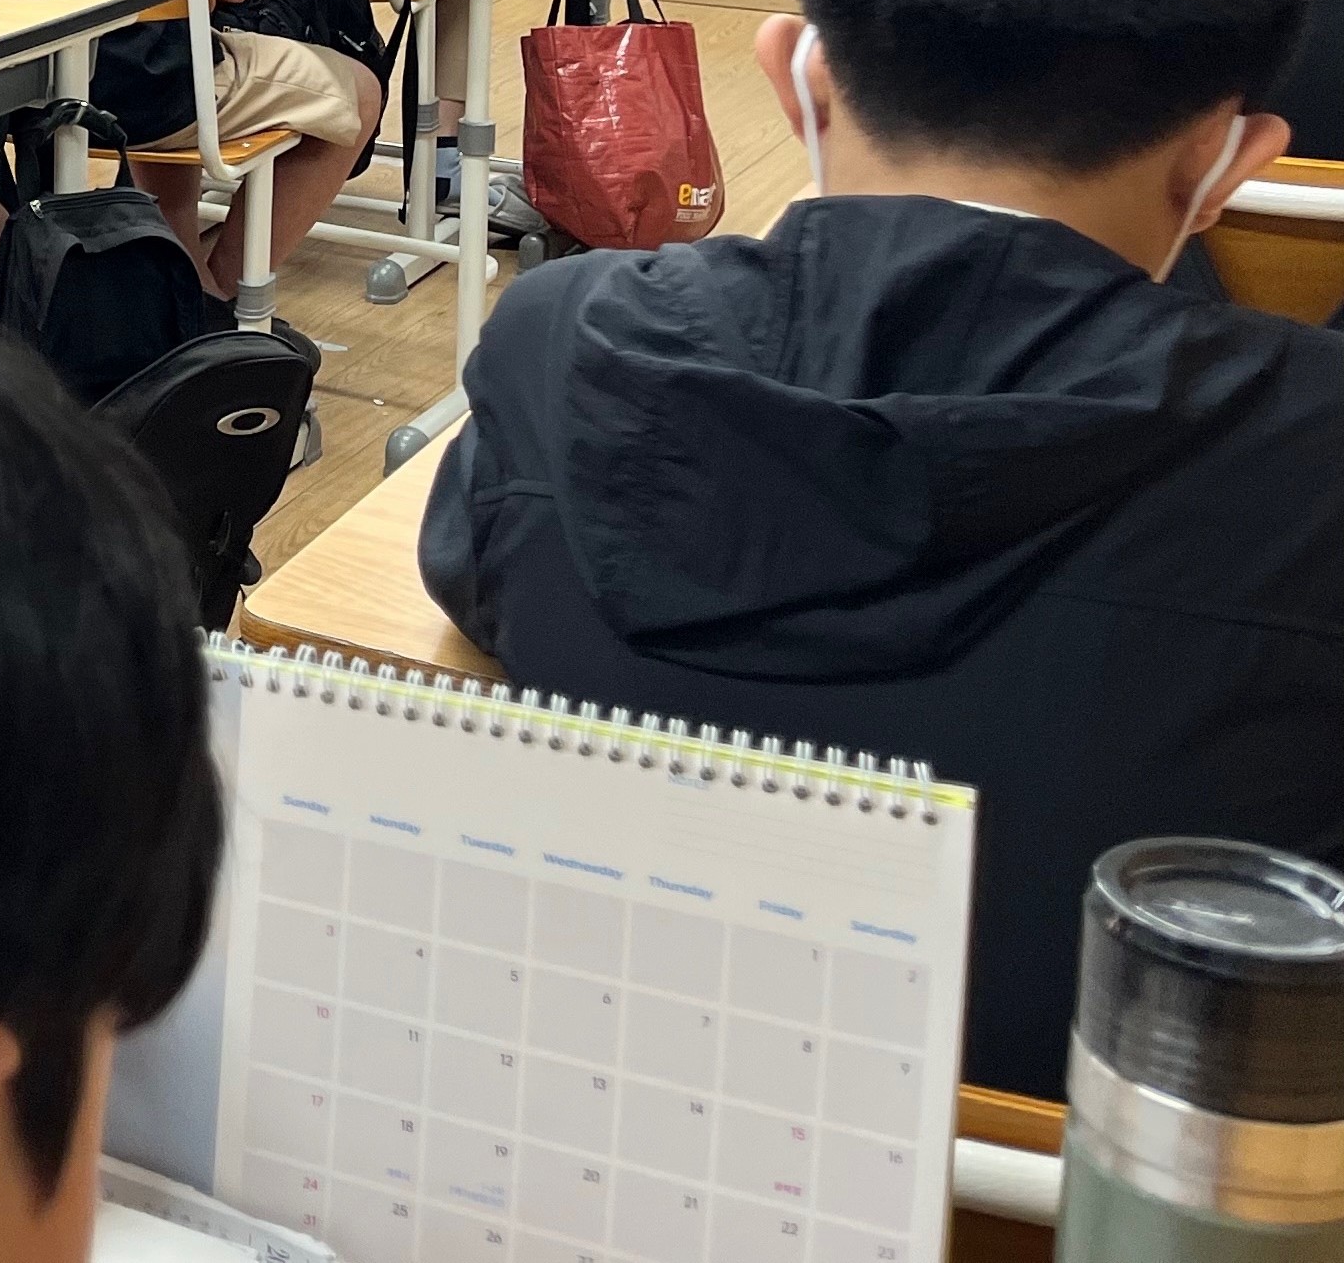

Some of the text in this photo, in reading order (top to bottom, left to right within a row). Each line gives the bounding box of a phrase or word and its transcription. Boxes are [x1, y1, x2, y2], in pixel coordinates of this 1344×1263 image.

[283, 796, 330, 815] Sunday
[370, 815, 421, 836] Monday
[461, 834, 515, 856] Tuesday
[543, 853, 623, 880] Wednesday
[649, 876, 713, 900] Thursday
[326, 925, 335, 937] 3
[416, 948, 423, 958] 4
[510, 970, 519, 982] 5
[602, 993, 611, 1004] 6
[802, 1041, 812, 1053] 8
[812, 949, 818, 961] 1
[316, 1005, 330, 1019] 10
[409, 1029, 419, 1042] 11
[500, 1053, 513, 1067] 12
[593, 1077, 606, 1091] 13
[791, 1126, 806, 1141] 15
[303, 1177, 318, 1190] 24
[392, 1203, 408, 1218] 25
[486, 1229, 502, 1244] 26
[303, 1213, 317, 1226] 31
[312, 1095, 895, 1260] 17 18 19 20 21 22 23
